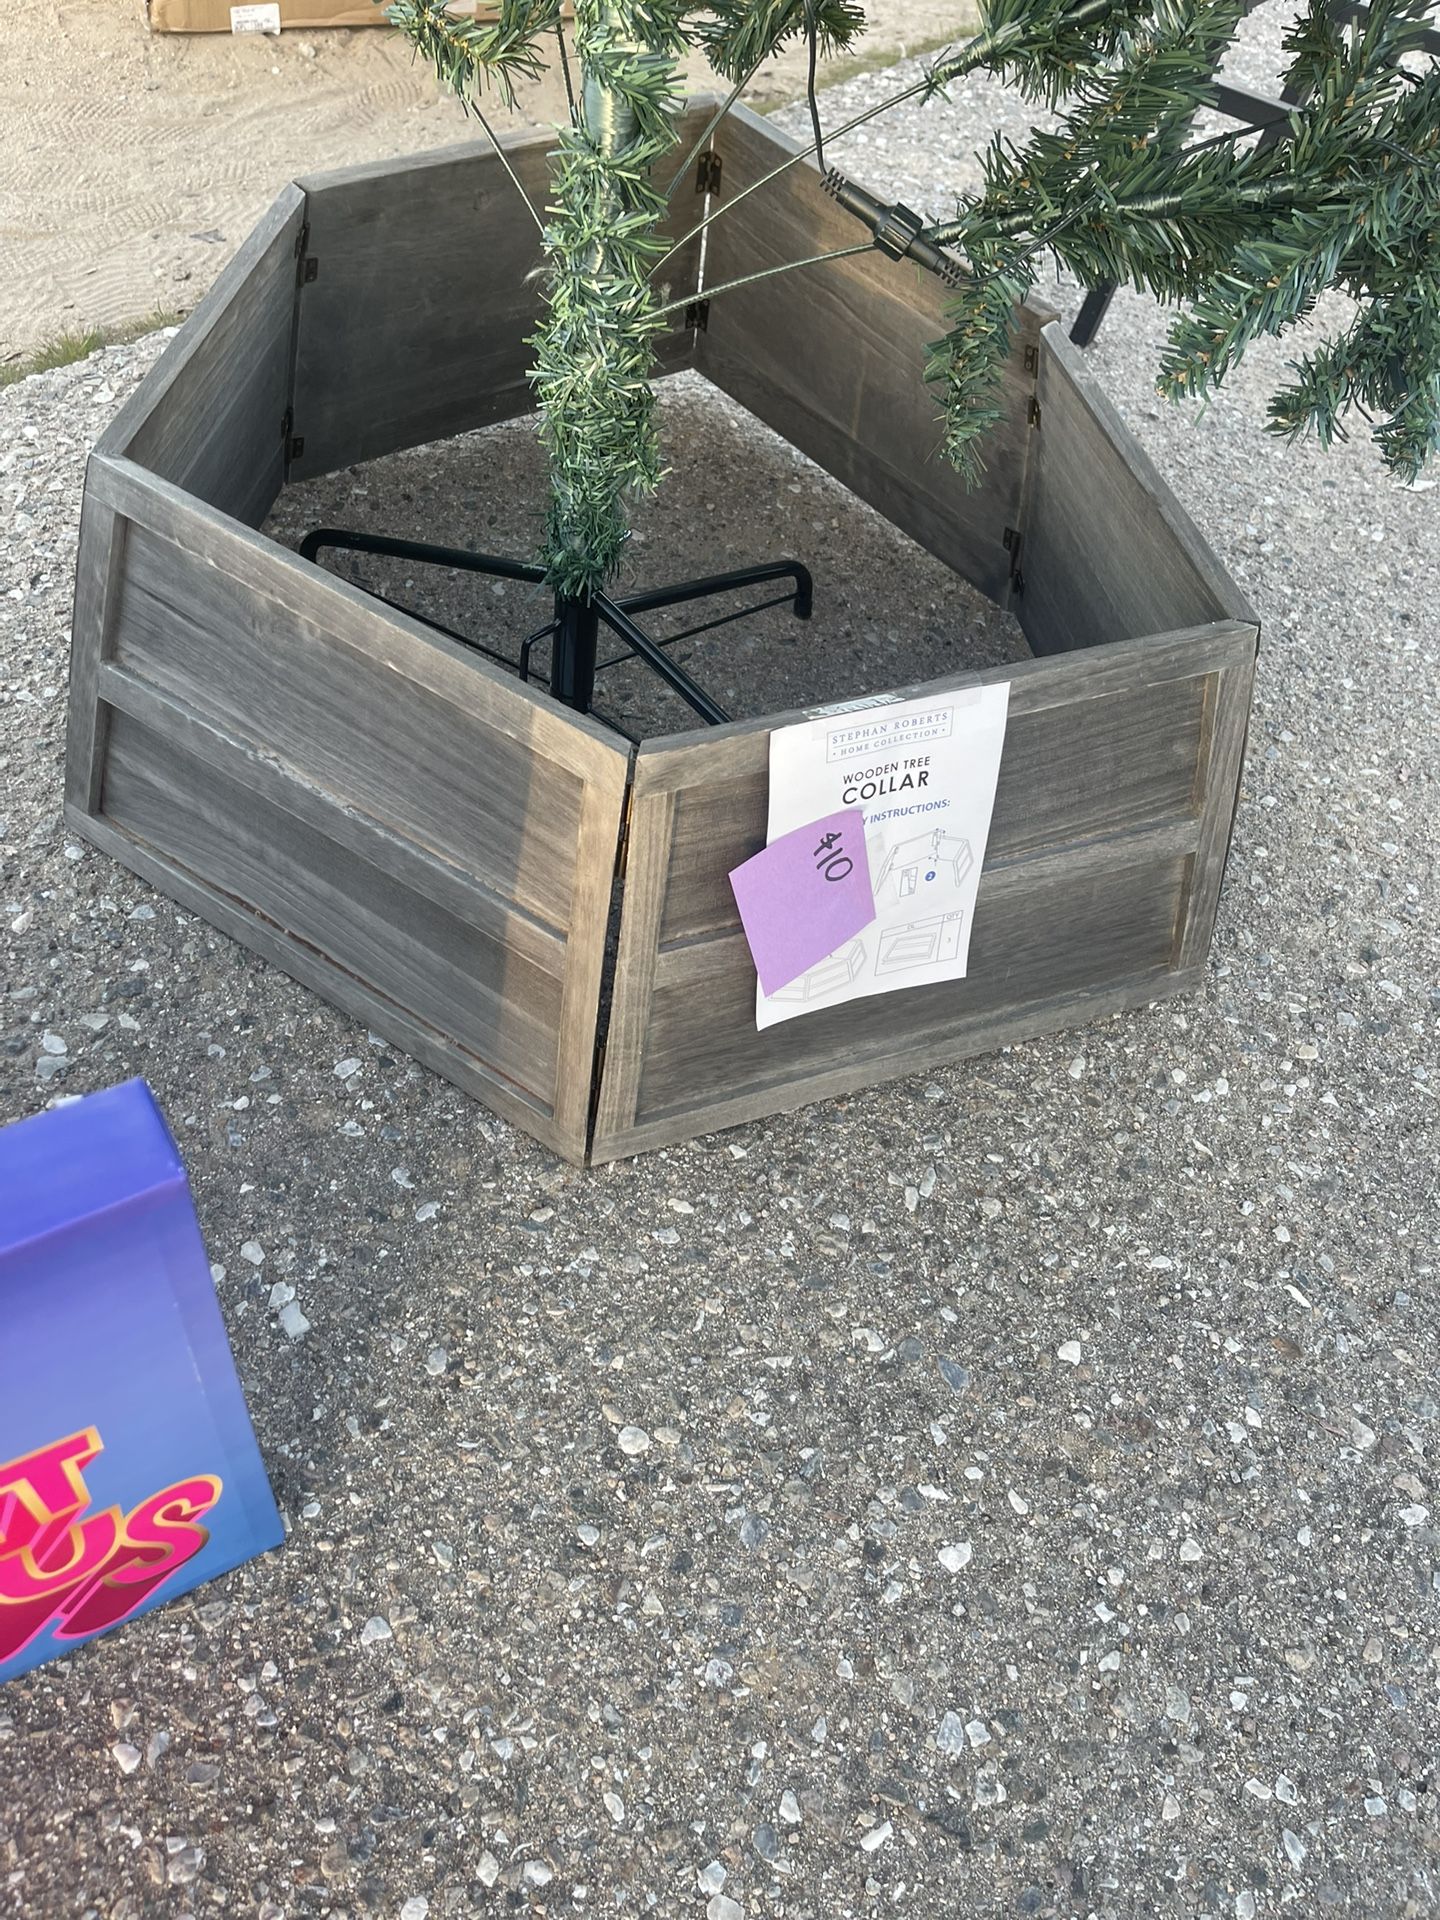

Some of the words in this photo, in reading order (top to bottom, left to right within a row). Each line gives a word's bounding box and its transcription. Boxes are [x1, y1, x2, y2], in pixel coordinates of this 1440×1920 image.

[832, 724, 888, 745] STEPHAN
[894, 712, 948, 730] ROBERTS
[841, 743, 869, 756] HOME
[873, 728, 938, 748] COLLECTION
[843, 762, 899, 785] WOODEN
[903, 756, 931, 770] TREE
[842, 770, 929, 805] COLLAR
[870, 798, 951, 824] INSTRUCTIONS:
[813, 831, 853, 882] $10
